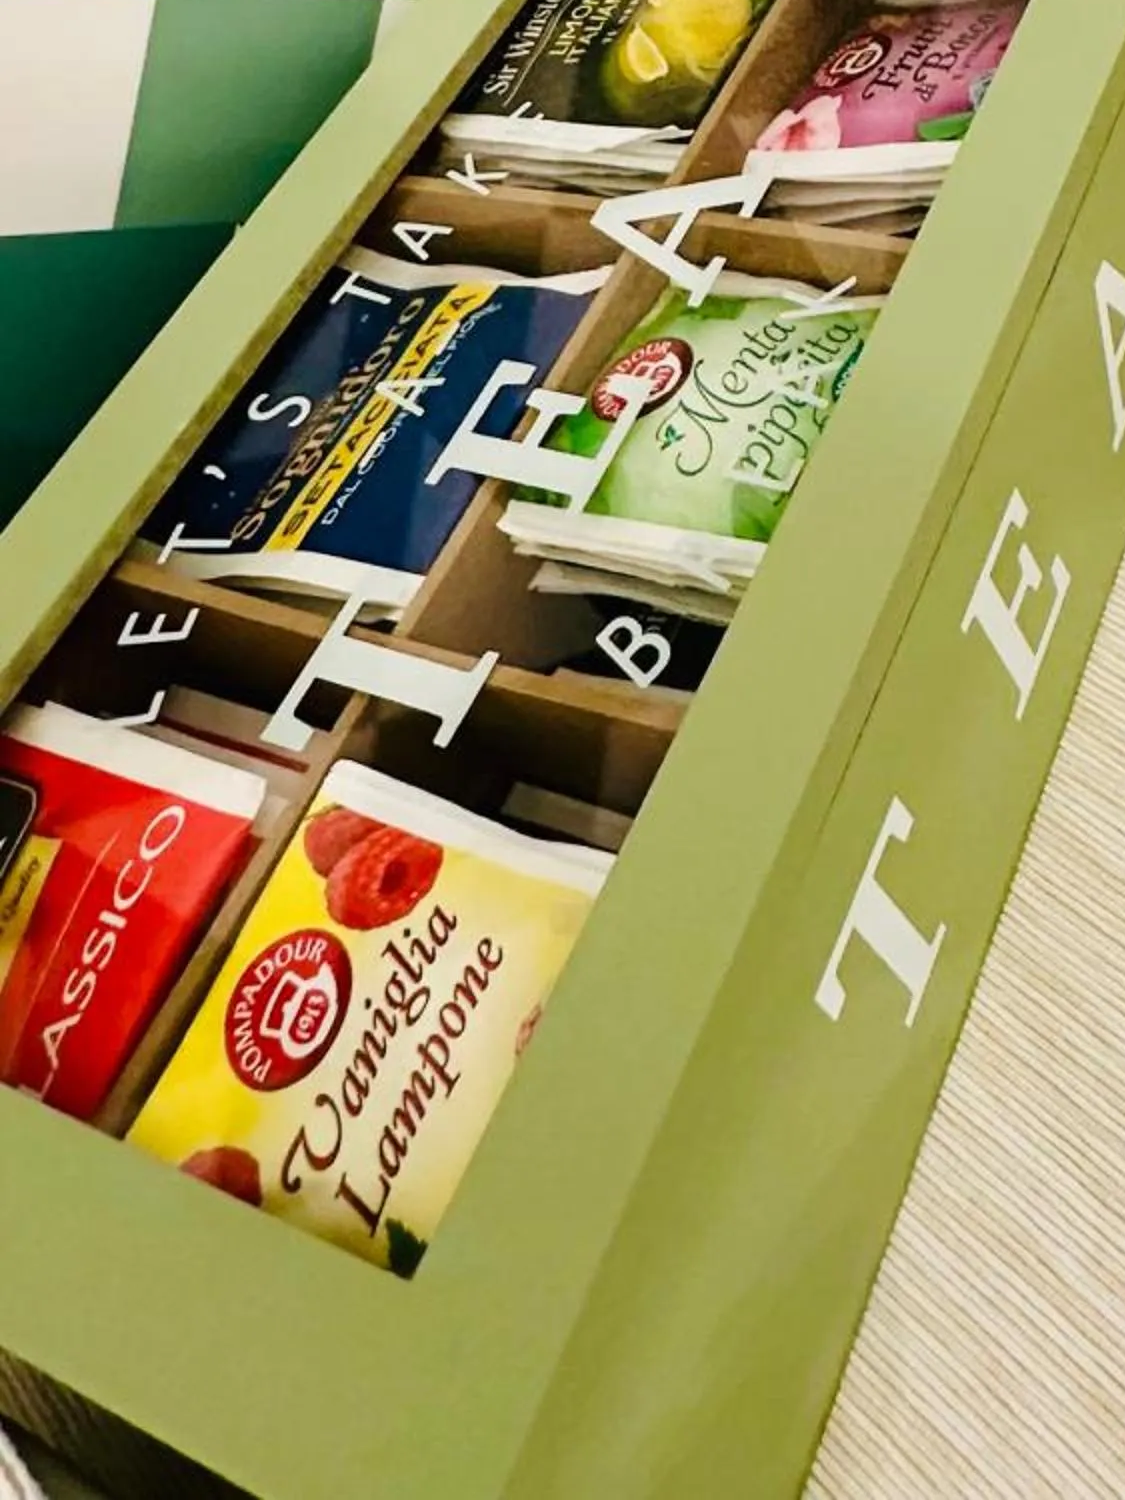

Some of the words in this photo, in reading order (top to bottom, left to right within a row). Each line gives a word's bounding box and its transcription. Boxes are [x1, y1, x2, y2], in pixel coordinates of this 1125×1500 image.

[482, 65, 519, 96] Sir
[912, 13, 999, 82] Bosco
[259, 149, 777, 750] TEA
[655, 319, 796, 477] Menta
[321, 476, 363, 525] DAL
[233, 937, 328, 1084] POMPADOUR
[280, 904, 457, 1194] Vaniglia
[295, 990, 327, 1040] 1913
[334, 937, 504, 1239] Lampone
